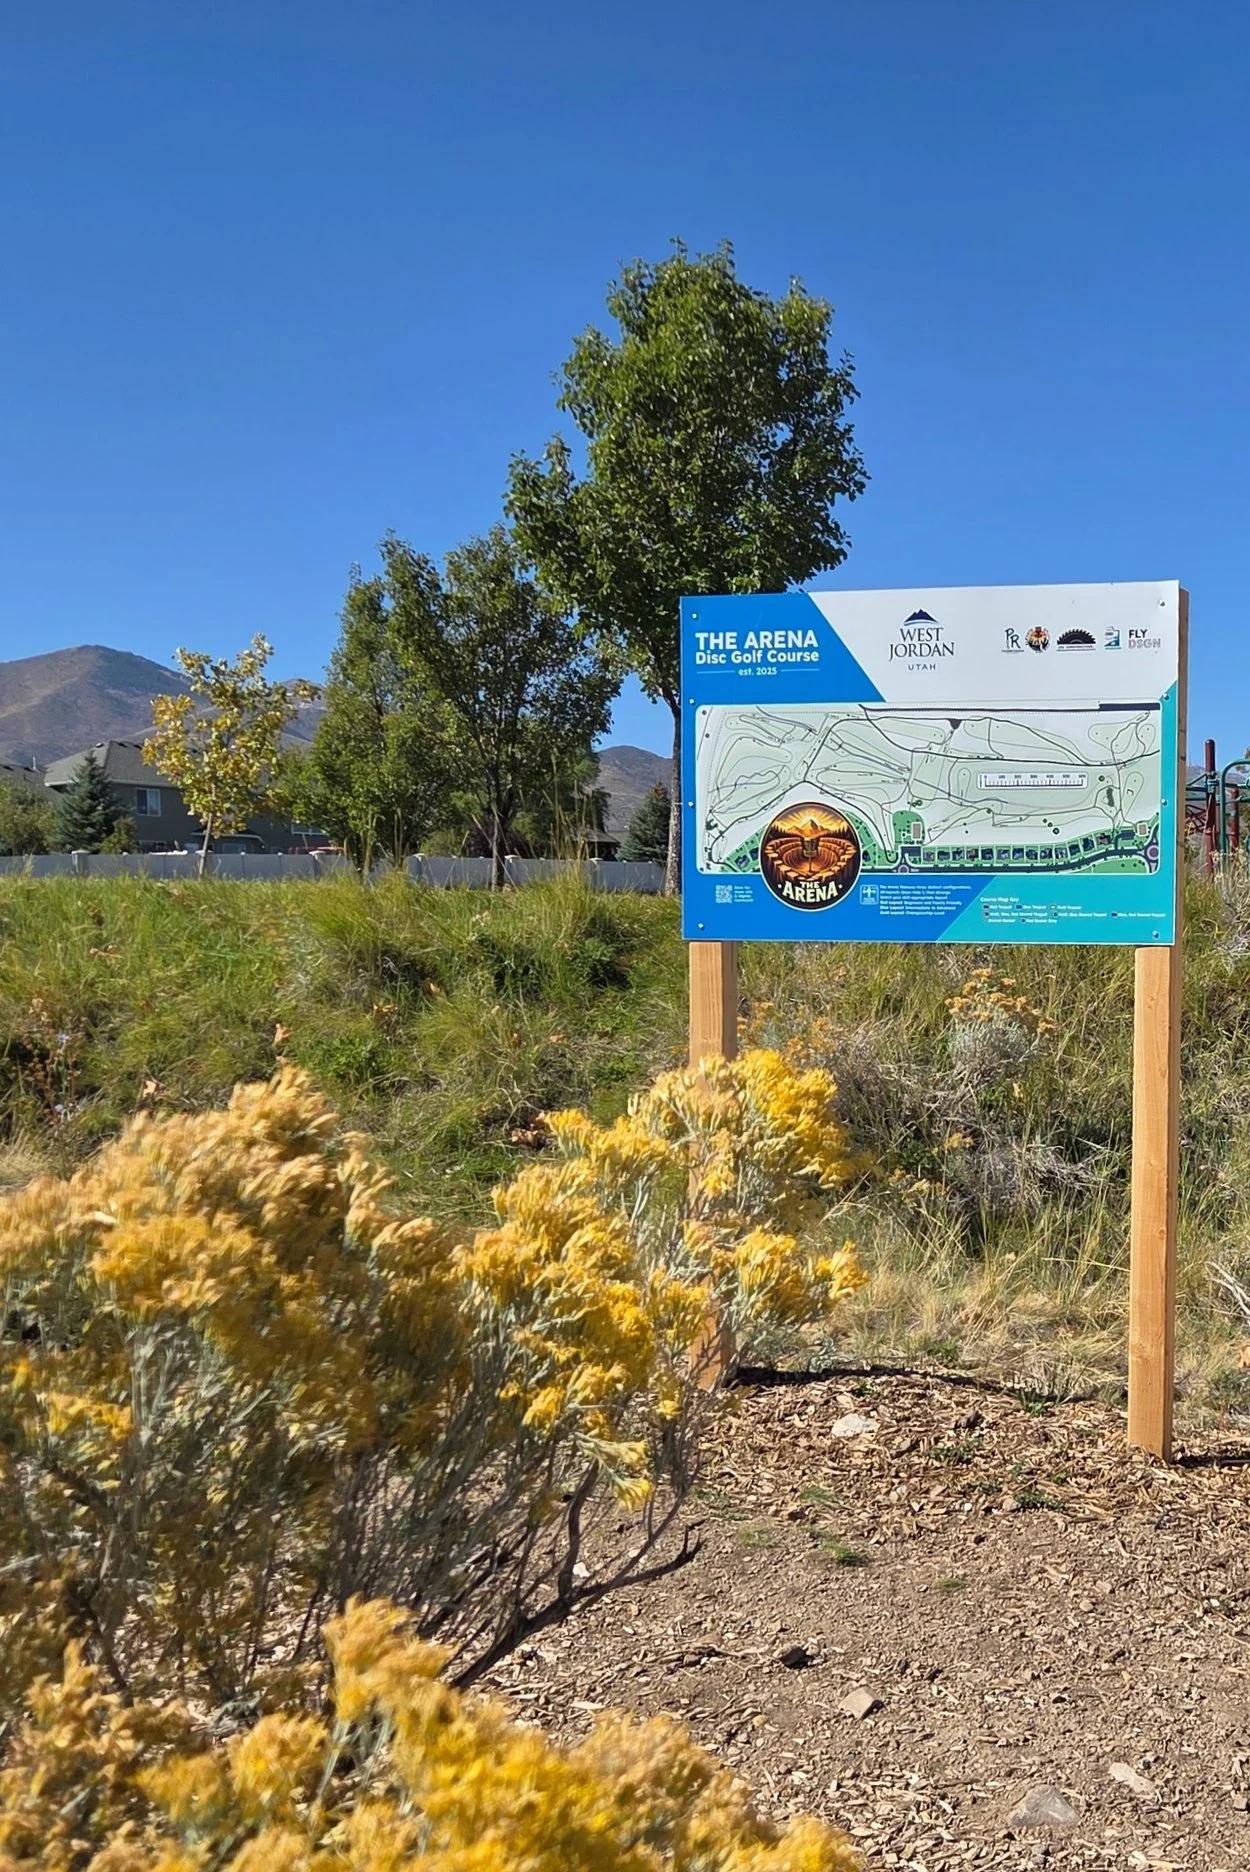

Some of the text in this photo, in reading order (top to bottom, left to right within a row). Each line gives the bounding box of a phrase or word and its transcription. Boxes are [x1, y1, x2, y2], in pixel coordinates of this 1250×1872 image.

[695, 630, 818, 650] THE ARENA
[900, 626, 943, 642] WEST
[1129, 629, 1147, 638] FLY
[1129, 639, 1160, 649] DSGN
[696, 650, 819, 664] Disc Golf Course
[889, 642, 954, 661] JORDAN
[739, 667, 777, 676] est. 2025
[782, 880, 839, 903] ARENA
[799, 882, 821, 890] THE
